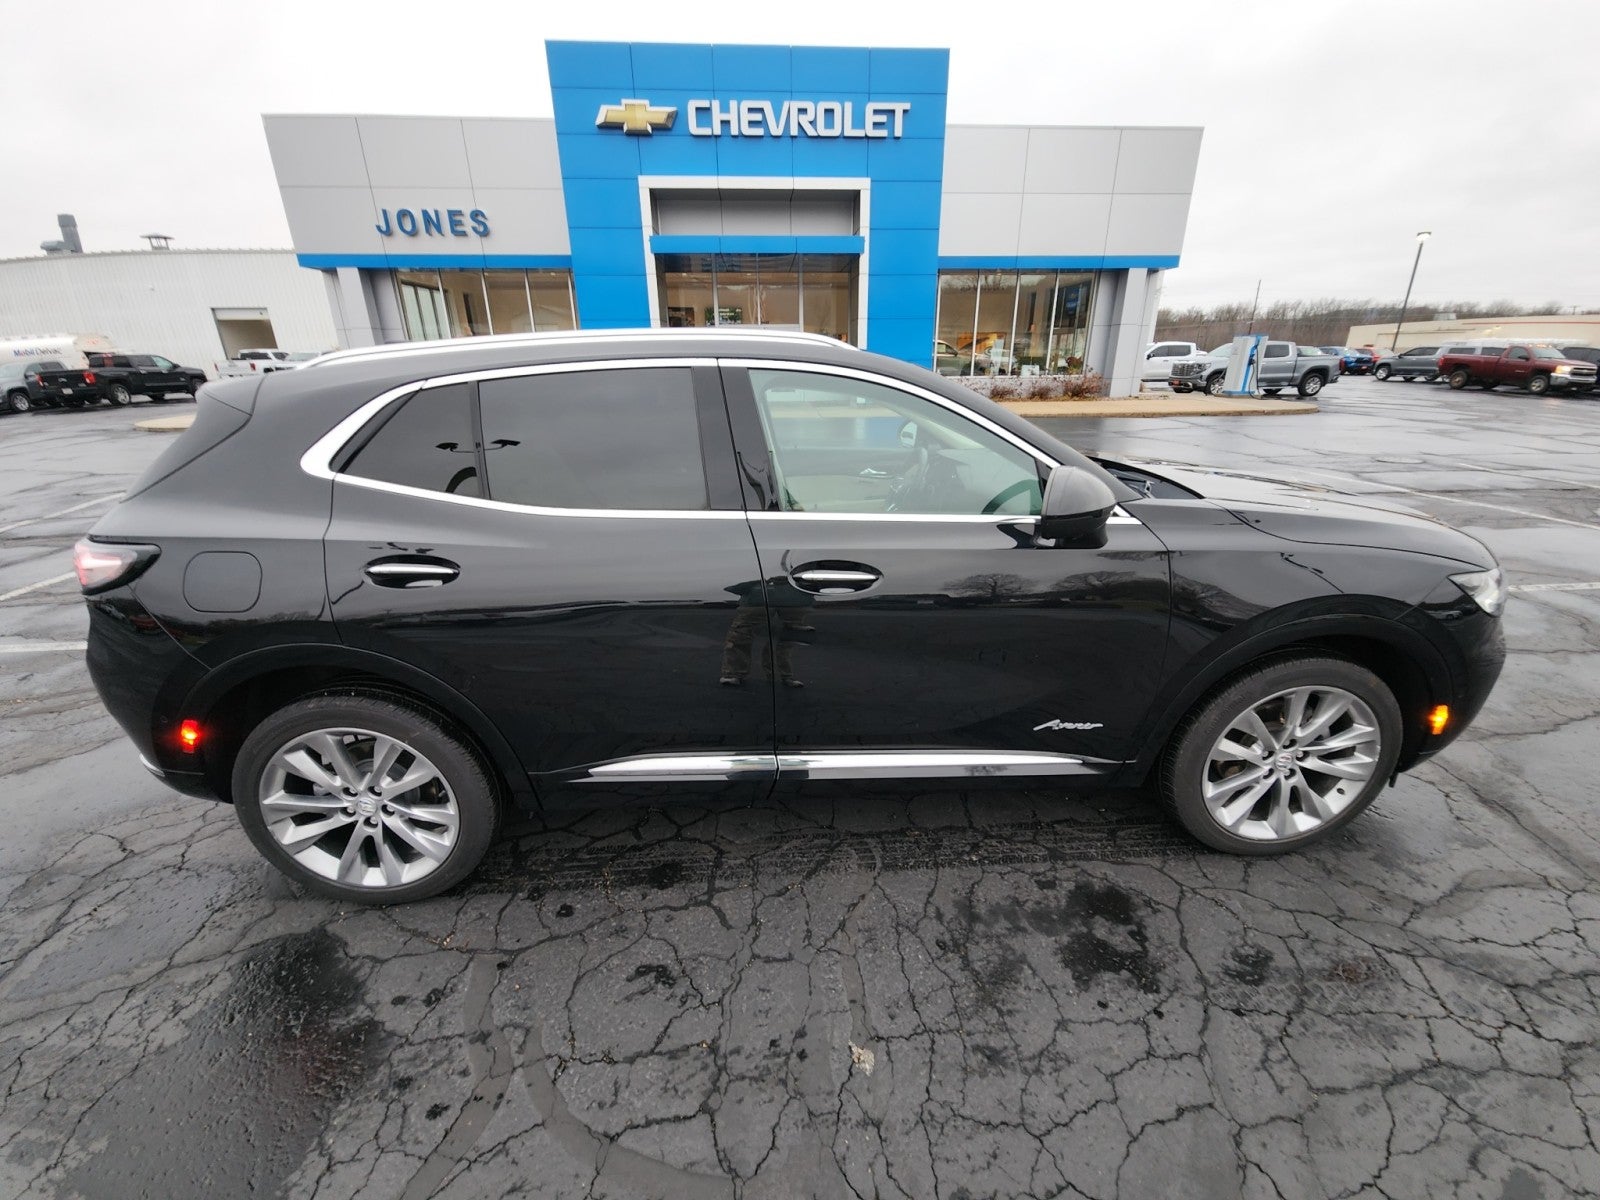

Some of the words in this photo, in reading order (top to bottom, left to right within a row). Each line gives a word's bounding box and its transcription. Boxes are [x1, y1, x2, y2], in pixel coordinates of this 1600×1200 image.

[687, 99, 911, 138] CHEVROLET
[375, 208, 491, 237] JONES
[13, 348, 35, 357] Mobil
